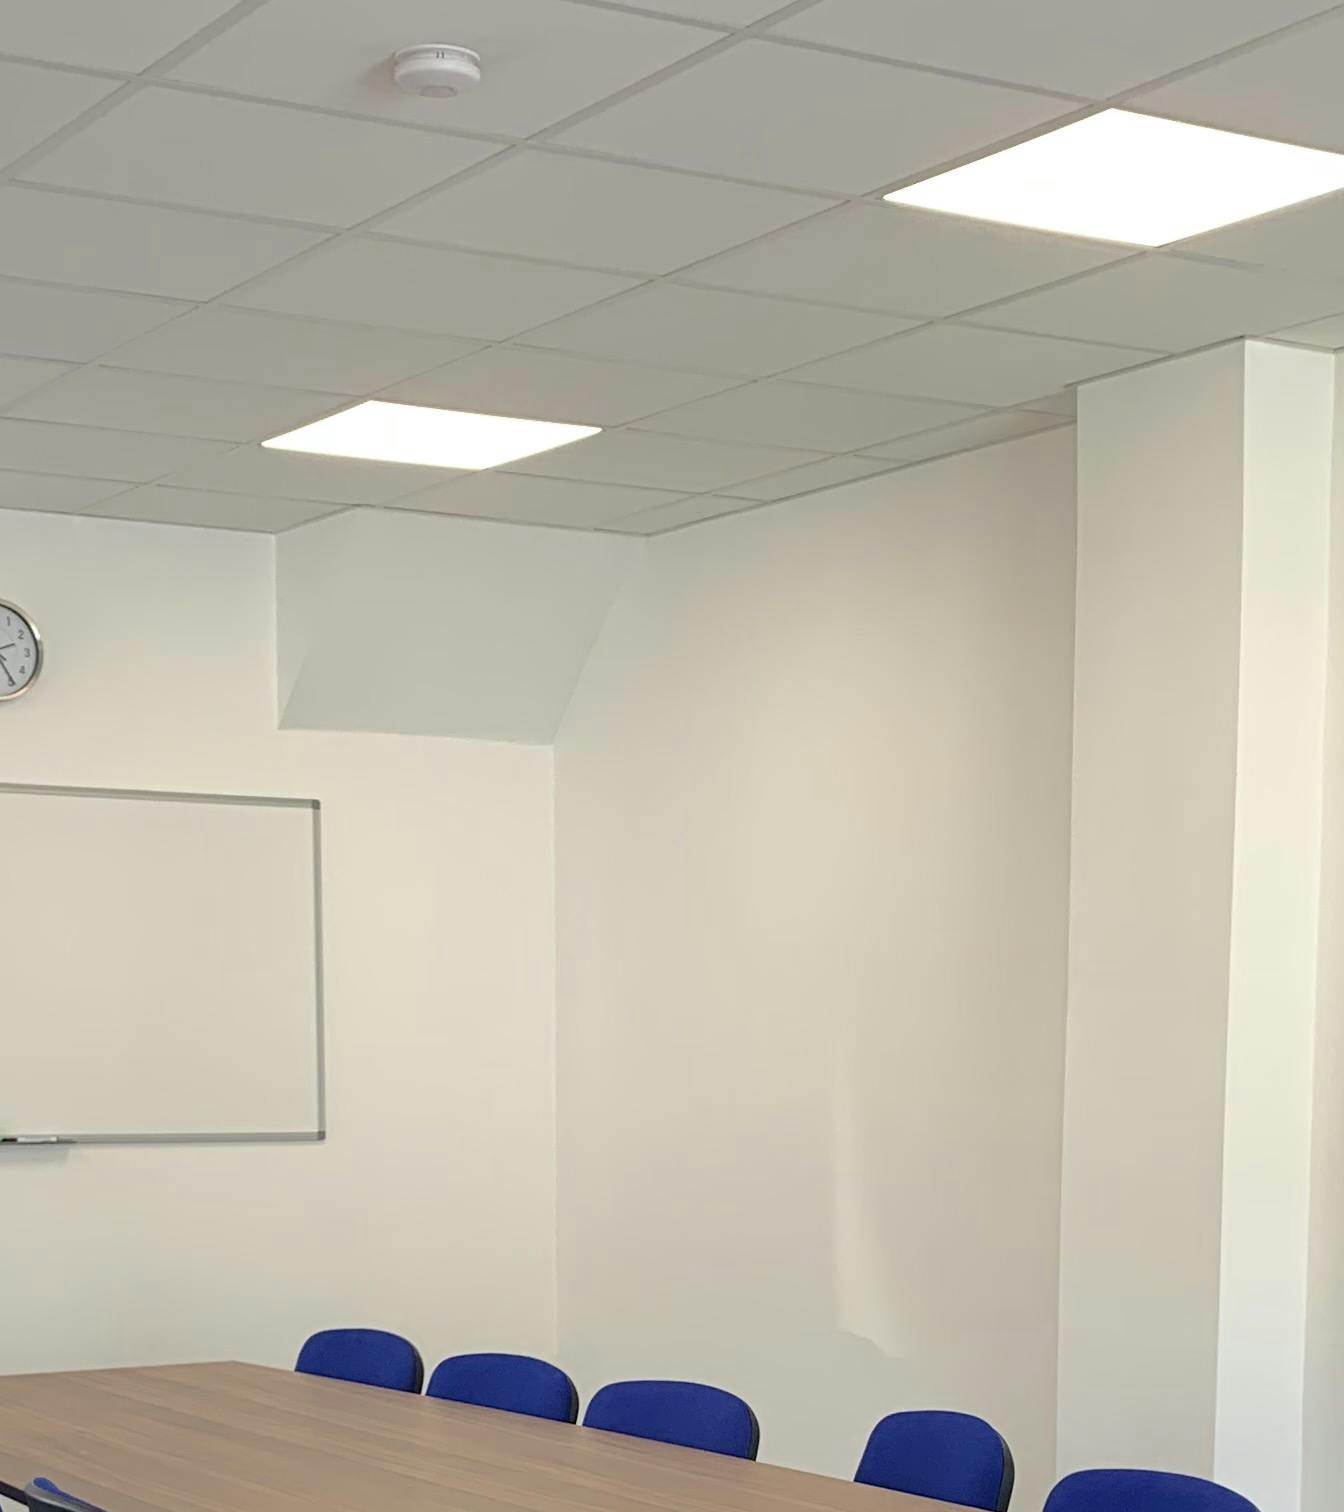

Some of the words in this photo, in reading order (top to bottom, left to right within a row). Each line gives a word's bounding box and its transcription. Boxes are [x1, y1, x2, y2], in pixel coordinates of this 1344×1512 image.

[6, 616, 11, 626] 1
[17, 629, 24, 640] 2
[24, 648, 30, 657] 3
[19, 666, 25, 674] 4
